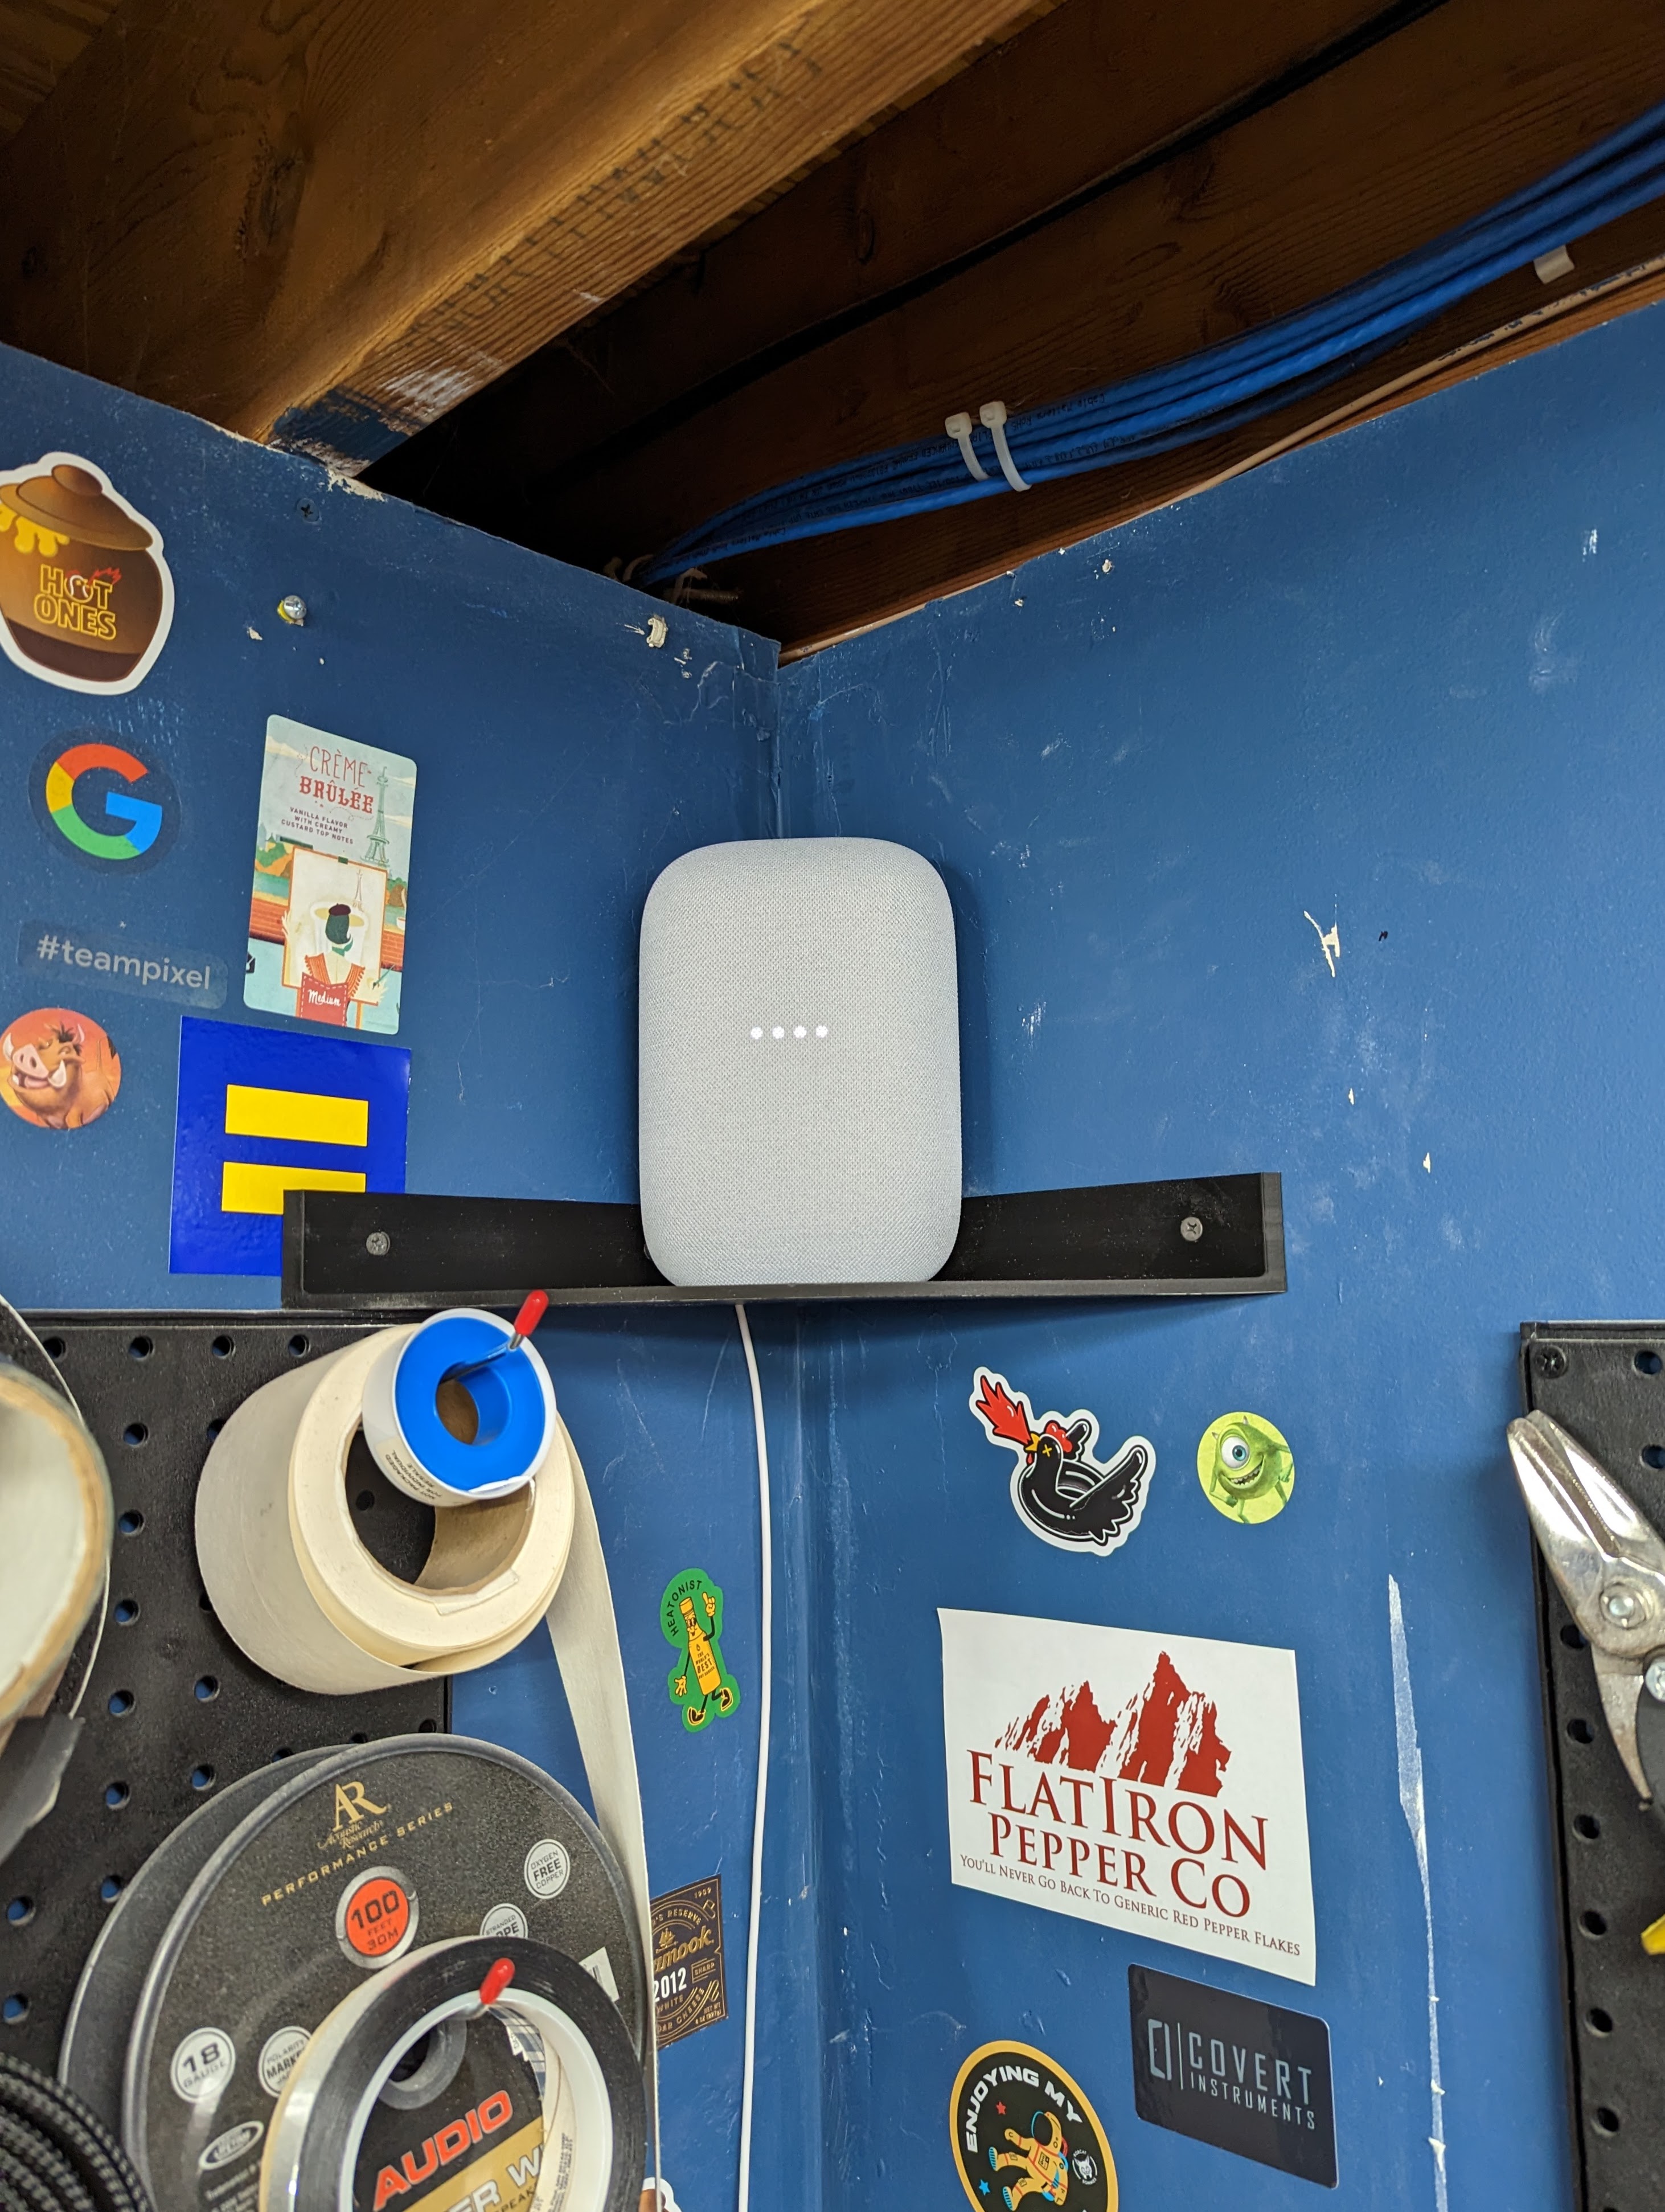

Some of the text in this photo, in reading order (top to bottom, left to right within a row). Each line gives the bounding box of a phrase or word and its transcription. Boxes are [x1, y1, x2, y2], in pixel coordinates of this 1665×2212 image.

[40, 563, 113, 610] HOT
[34, 593, 116, 641] ONES
[310, 746, 368, 788] CRÈME
[300, 776, 374, 814] BRÛLÉE
[281, 819, 313, 833] CUSTARD
[332, 833, 354, 844] NOTES
[290, 807, 348, 829] VANILLA FLAVOR
[294, 816, 342, 834] WITH CREAMY
[37, 934, 210, 990] #teampixel
[666, 1579, 702, 1637] HEATONIST
[697, 1658, 712, 1674] BEST
[967, 1750, 1268, 1871] FLATIRON
[261, 1802, 453, 1906] PERFORMANCE SERIES
[531, 1850, 559, 1870] OXYGEN
[534, 1858, 561, 1881] FREE
[988, 1812, 1251, 1918] PEPPER CO
[536, 1869, 564, 1889] COPPER
[351, 1890, 400, 1929] 100
[667, 1908, 701, 1925] RESERVE
[960, 1854, 1301, 1956] YOU'LL NEVER GO BACK TO GENERIC RED PEPPER FLAKES
[367, 1927, 399, 1950] 30M
[368, 1918, 392, 1936] FEET
[486, 1914, 516, 1935] STRANDED
[654, 1967, 687, 2002] 2012
[695, 1963, 715, 1975] SHARP
[657, 1994, 683, 2013] WHITE
[676, 1988, 704, 2024] CHEESE
[183, 2042, 220, 2072] 18
[1189, 2032, 1311, 2105] COVERT
[966, 2066, 1082, 2153] ENJOYING MY
[1191, 2071, 1314, 2129] INSTRUMENTS
[374, 2090, 512, 2211] AUDIO
